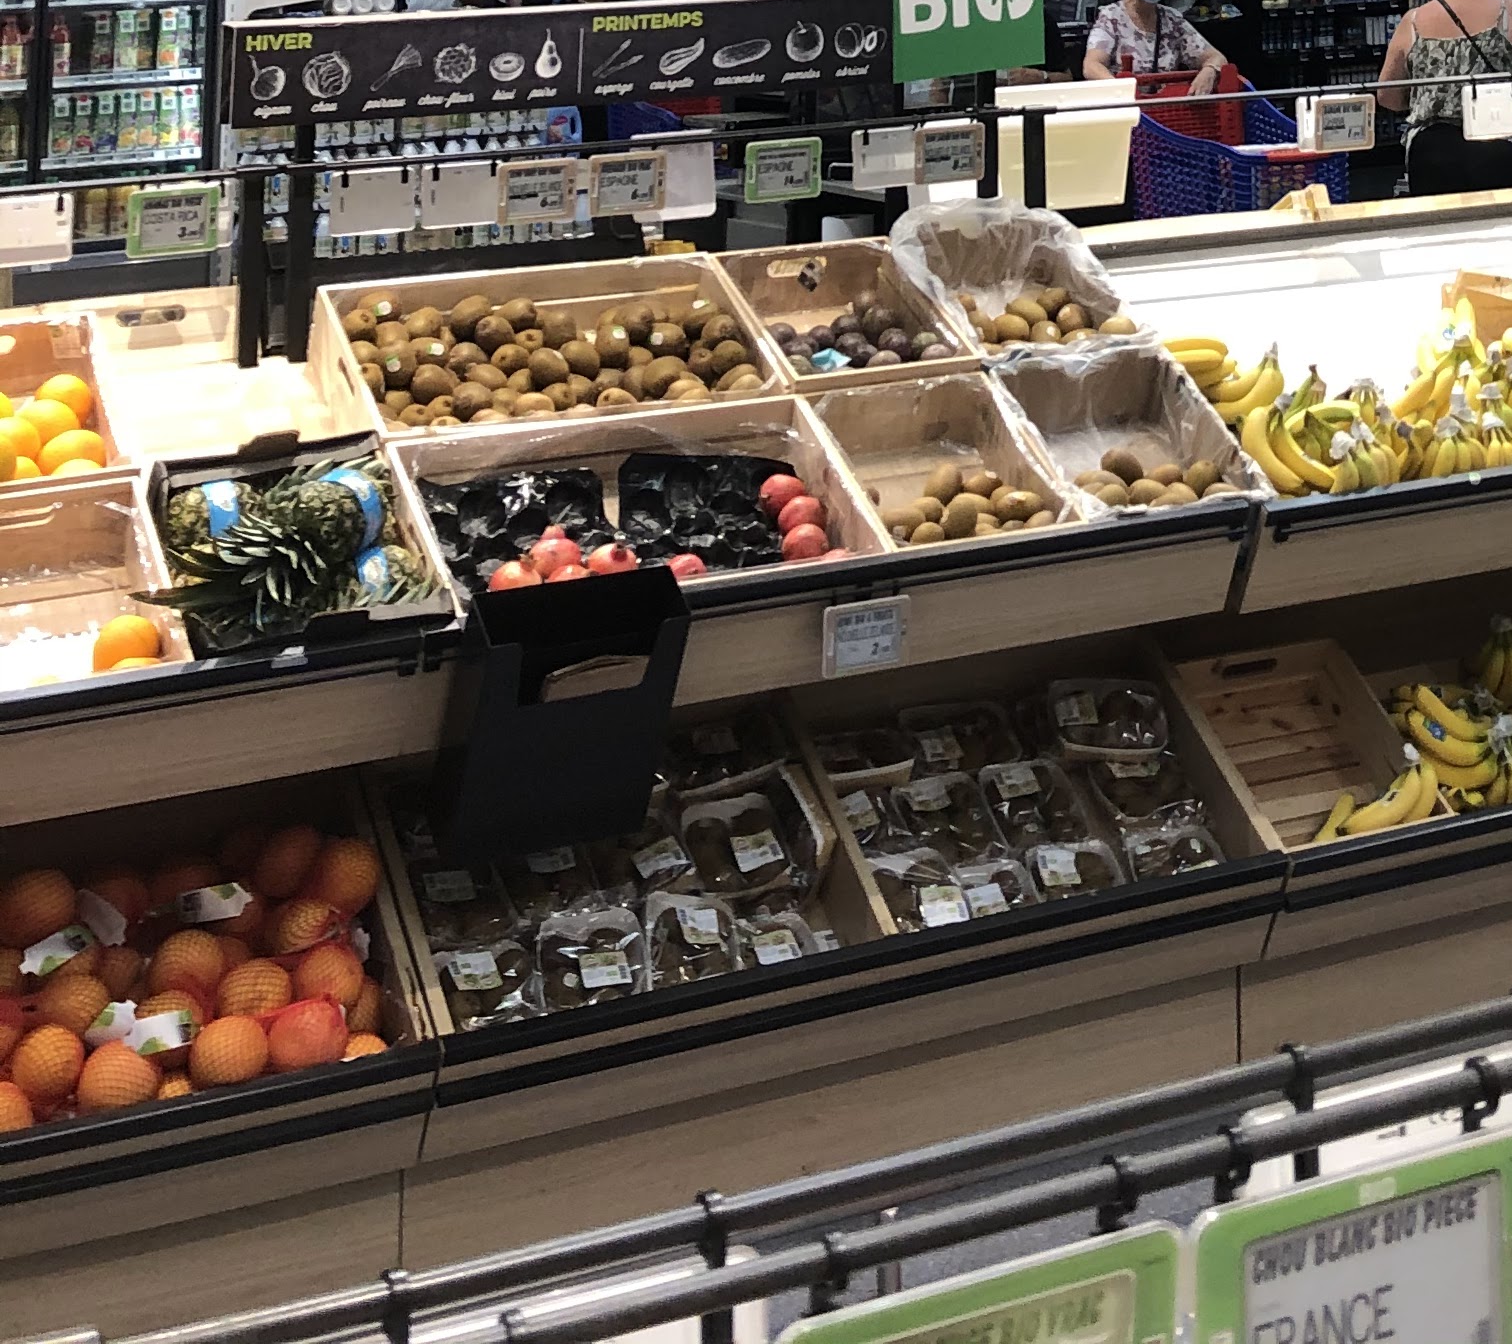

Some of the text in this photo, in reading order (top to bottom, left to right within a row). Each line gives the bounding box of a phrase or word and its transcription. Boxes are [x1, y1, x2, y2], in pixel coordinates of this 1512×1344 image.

[245, 11, 704, 52] HIVER PRINTEMPS
[1252, 1238, 1308, 1285] CHOU
[1314, 1215, 1379, 1266] BLANC
[1384, 1203, 1419, 1245] BIO
[1253, 1283, 1396, 1344] FRANCE
